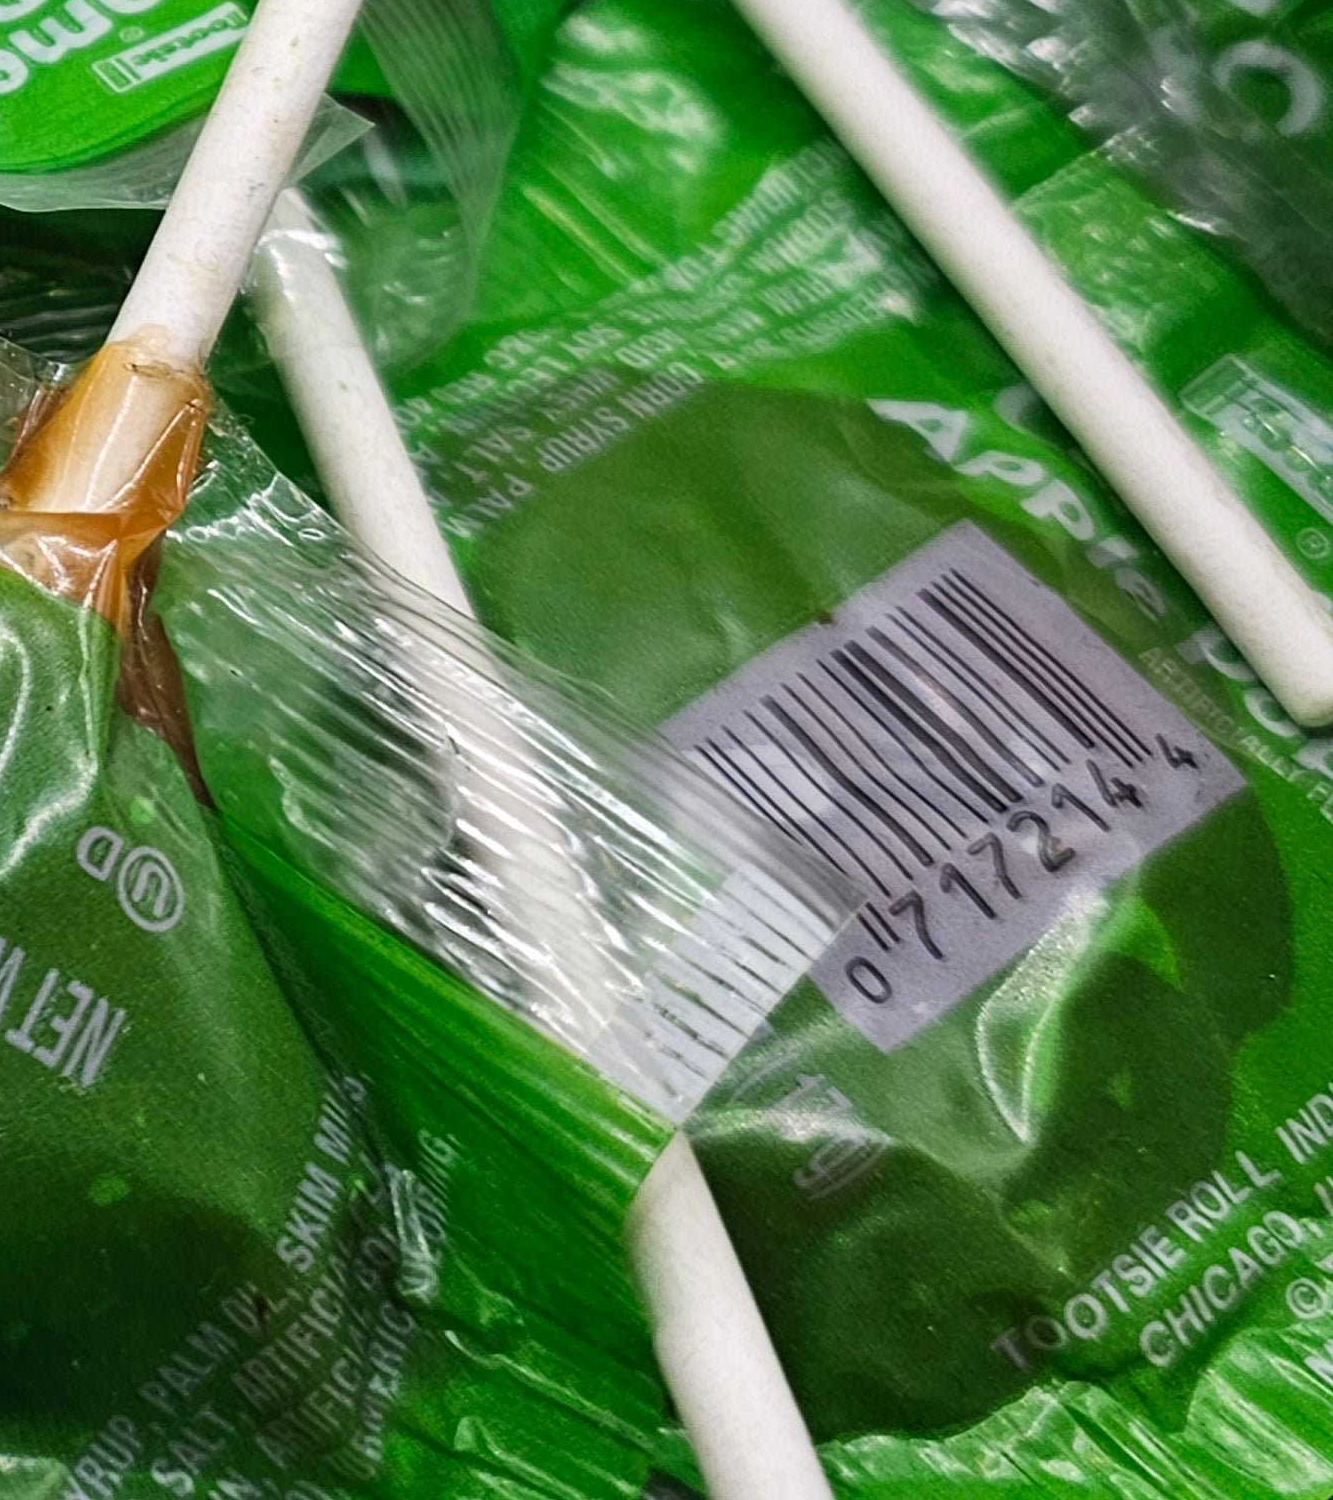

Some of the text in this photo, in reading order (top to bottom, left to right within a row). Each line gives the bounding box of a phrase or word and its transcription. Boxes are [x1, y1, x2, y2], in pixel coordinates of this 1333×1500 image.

[630, 361, 703, 420] CORN
[441, 472, 534, 539] PALM
[1155, 732, 1199, 770] 4
[888, 759, 1144, 961] 717214
[6, 967, 127, 1089] NET
[844, 956, 892, 1004] 0
[136, 1320, 232, 1416] PALM
[274, 1161, 345, 1276] SKIM
[989, 1224, 1187, 1375] TOOTSIE
[1164, 1150, 1283, 1244] ROLL
[1138, 1210, 1325, 1368] CHICAGO,
[150, 1400, 251, 1498] SALT,
